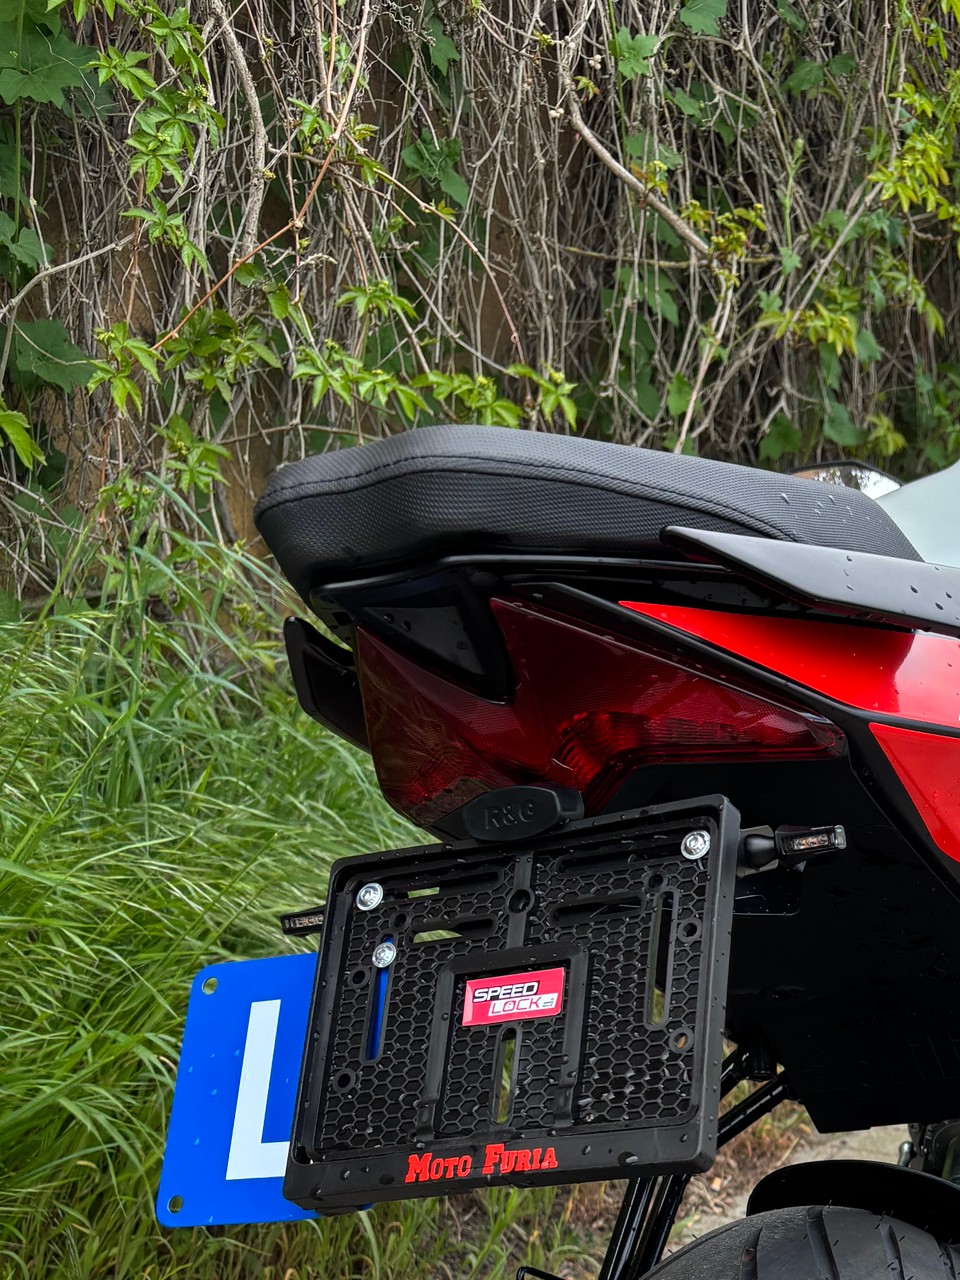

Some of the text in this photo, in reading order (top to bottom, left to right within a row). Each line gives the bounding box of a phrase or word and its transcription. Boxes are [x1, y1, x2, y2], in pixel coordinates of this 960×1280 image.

[484, 799, 538, 831] R&G
[472, 981, 539, 1003] SPEED
[491, 996, 543, 1015] LOCK
[226, 999, 290, 1181] L
